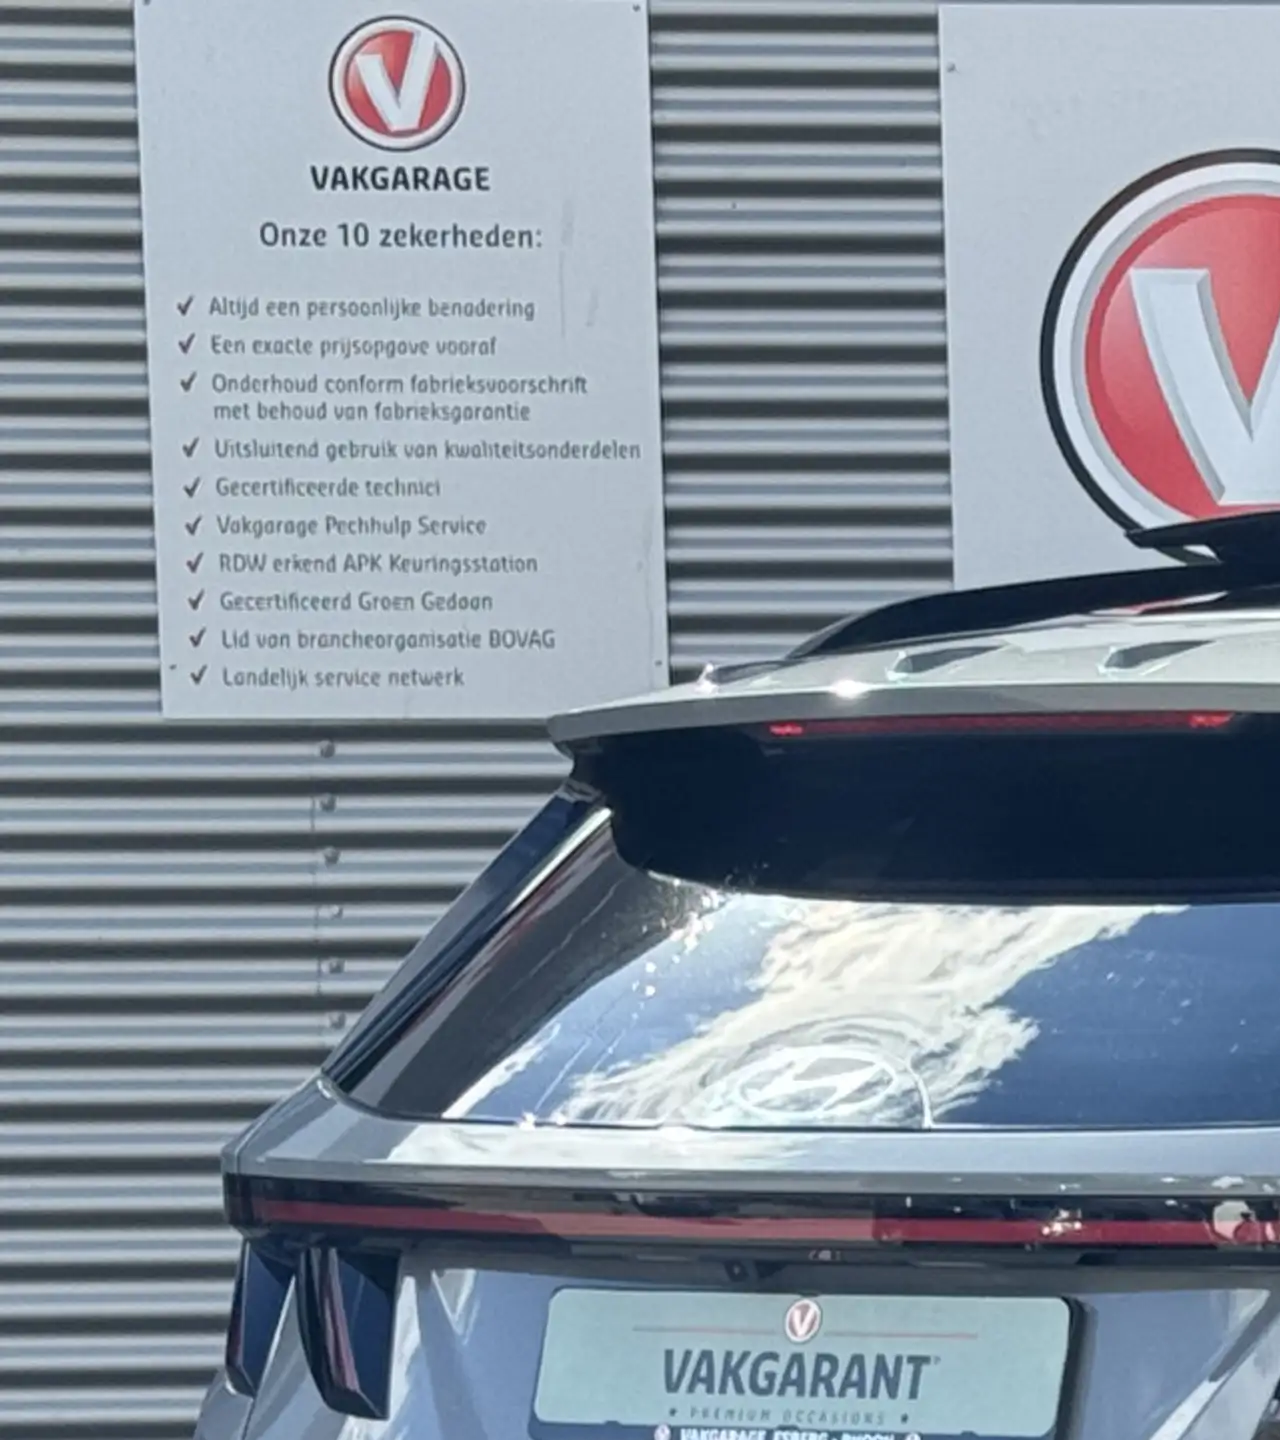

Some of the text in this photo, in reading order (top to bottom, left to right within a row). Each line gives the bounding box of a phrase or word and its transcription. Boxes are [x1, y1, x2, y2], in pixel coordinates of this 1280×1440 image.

[310, 165, 490, 191] VAKGARAGE
[260, 222, 541, 248] Onze 10 zekerheden:
[209, 297, 534, 321] Altijd een persoonlijke benadering
[211, 335, 496, 359] Een exacte prijsopgave vooraf
[212, 374, 587, 394] Onderhoud conform fabrieksvoorschrift
[214, 401, 530, 424] met behoud van fabrieksgarantie
[215, 439, 640, 462] Uitsluitend gebruik van kwaliteitsonderdelen
[216, 477, 440, 497] Gecertificeerde technici
[217, 515, 486, 538] Vakgarage Pechhulp Service
[219, 553, 537, 576] RDW erkend APK Keuringsstation
[220, 591, 492, 611] Gecertificeerd Groen Gedaan
[222, 629, 555, 653] Lid van brancheorganisatie BOVAG
[223, 668, 464, 690] Landelijk service netwerk
[663, 1349, 931, 1400] VAKGARANT
[690, 1407, 885, 1425] PREMIUM OCCASIONS
